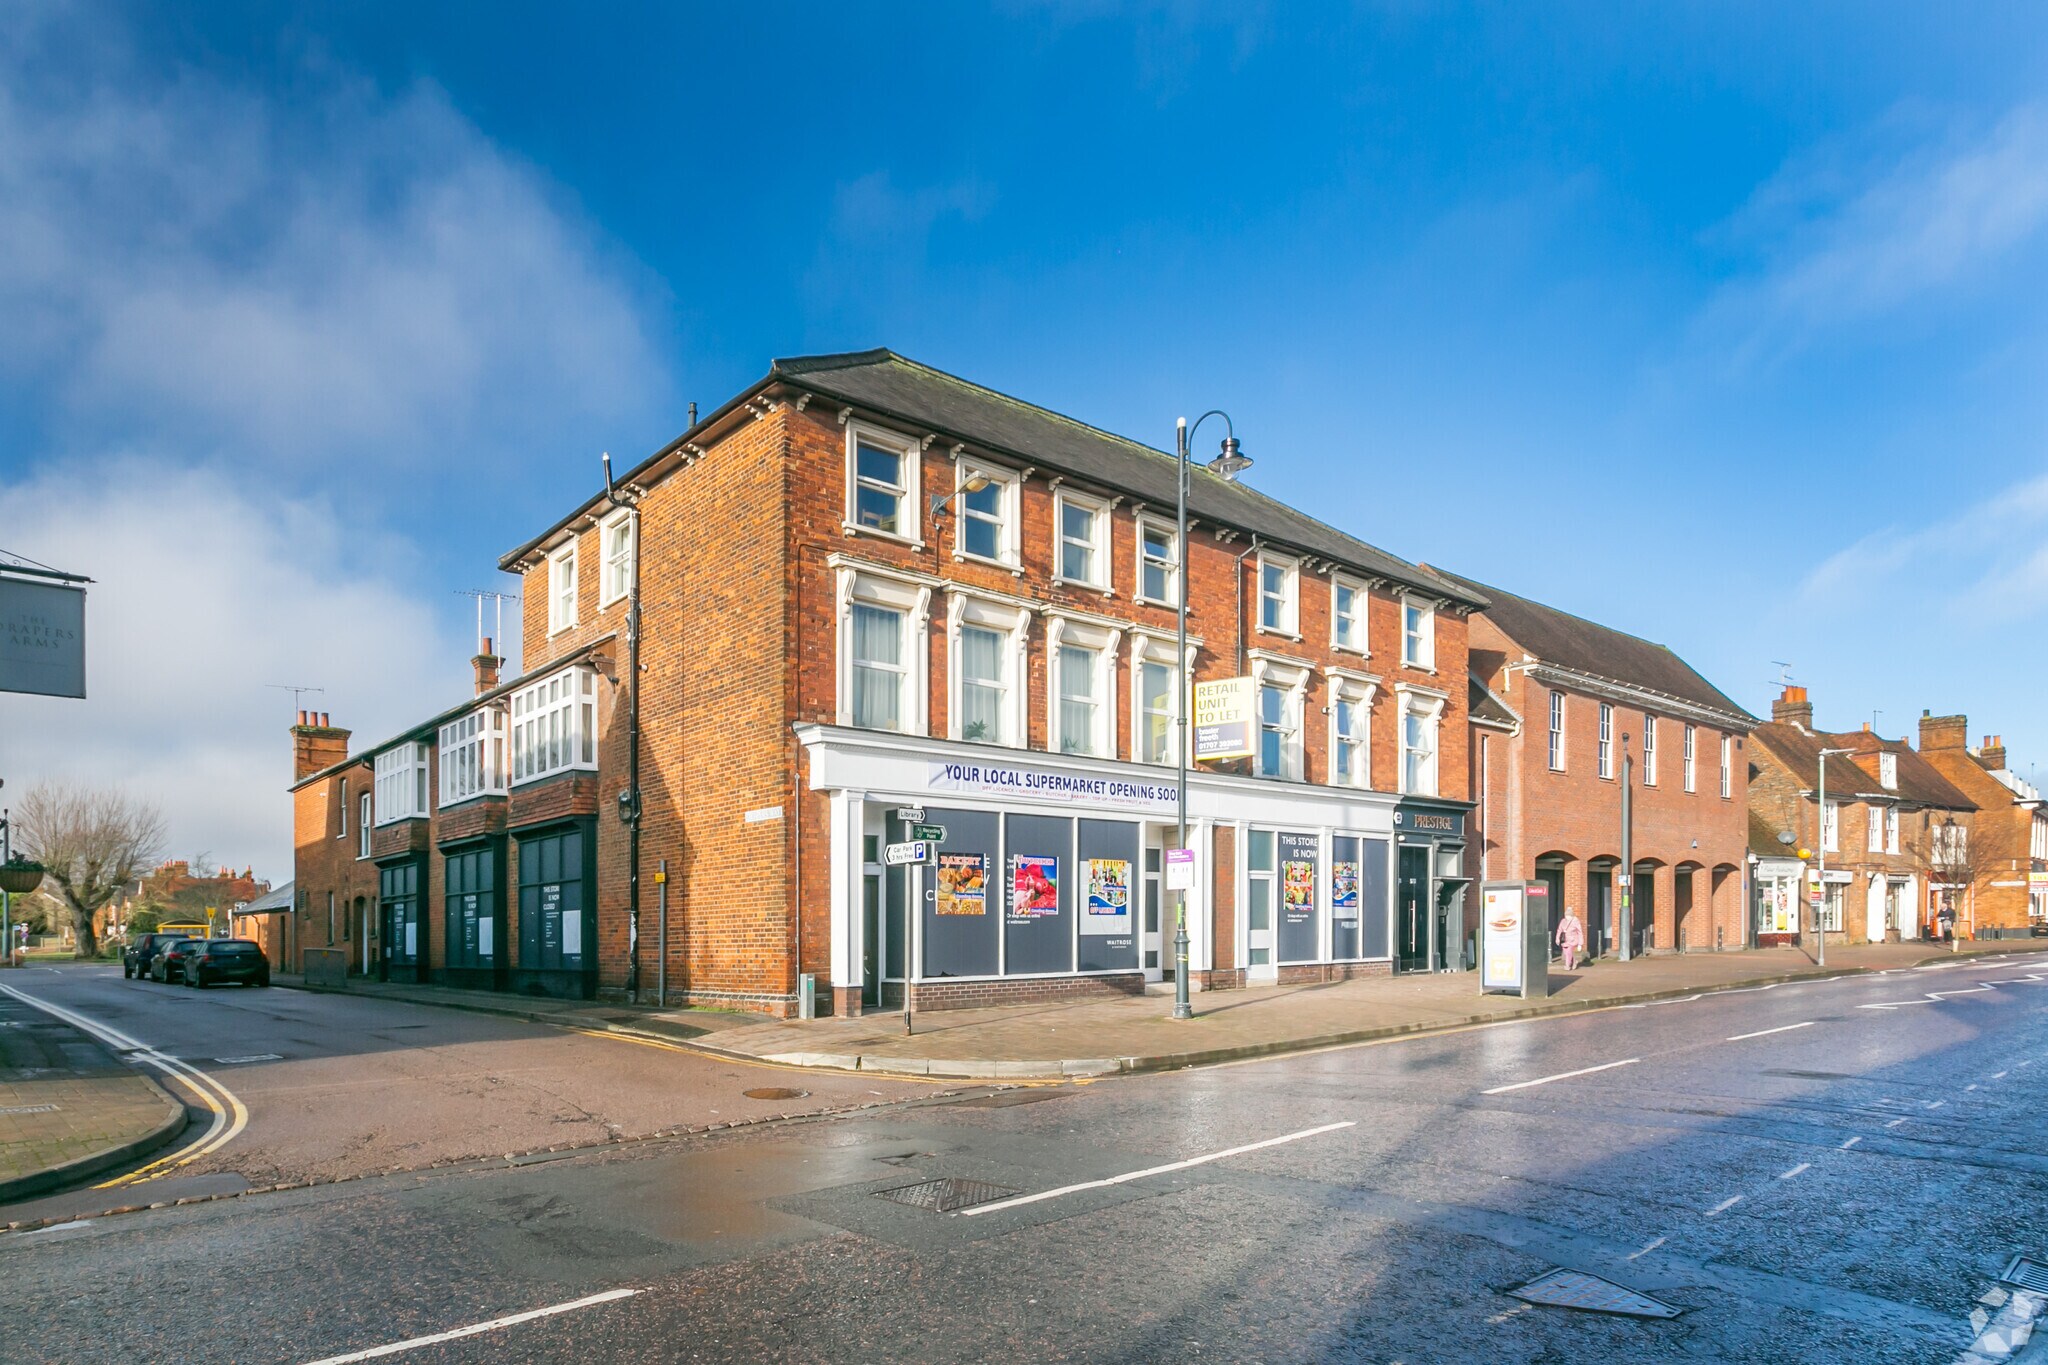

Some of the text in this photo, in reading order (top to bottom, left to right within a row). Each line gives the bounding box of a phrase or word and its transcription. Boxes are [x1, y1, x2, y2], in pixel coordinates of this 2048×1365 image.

[10, 635, 59, 648] ARMS
[1198, 683, 1240, 697] RETAIL
[1198, 697, 1228, 710] UNIT
[1198, 709, 1240, 723] TO LET
[1199, 741, 1218, 750] 01707
[945, 764, 979, 782] YOUR
[984, 769, 1022, 786] LOCAL
[1026, 773, 1106, 795] SUPERMARKET
[1109, 783, 1155, 800] OPENING
[900, 811, 920, 819] Library
[1414, 814, 1454, 830] PRESTIGE
[1282, 836, 1318, 847] THIS STORE
[940, 855, 982, 866] BAKERY
[1293, 849, 1318, 859] IS NOW
